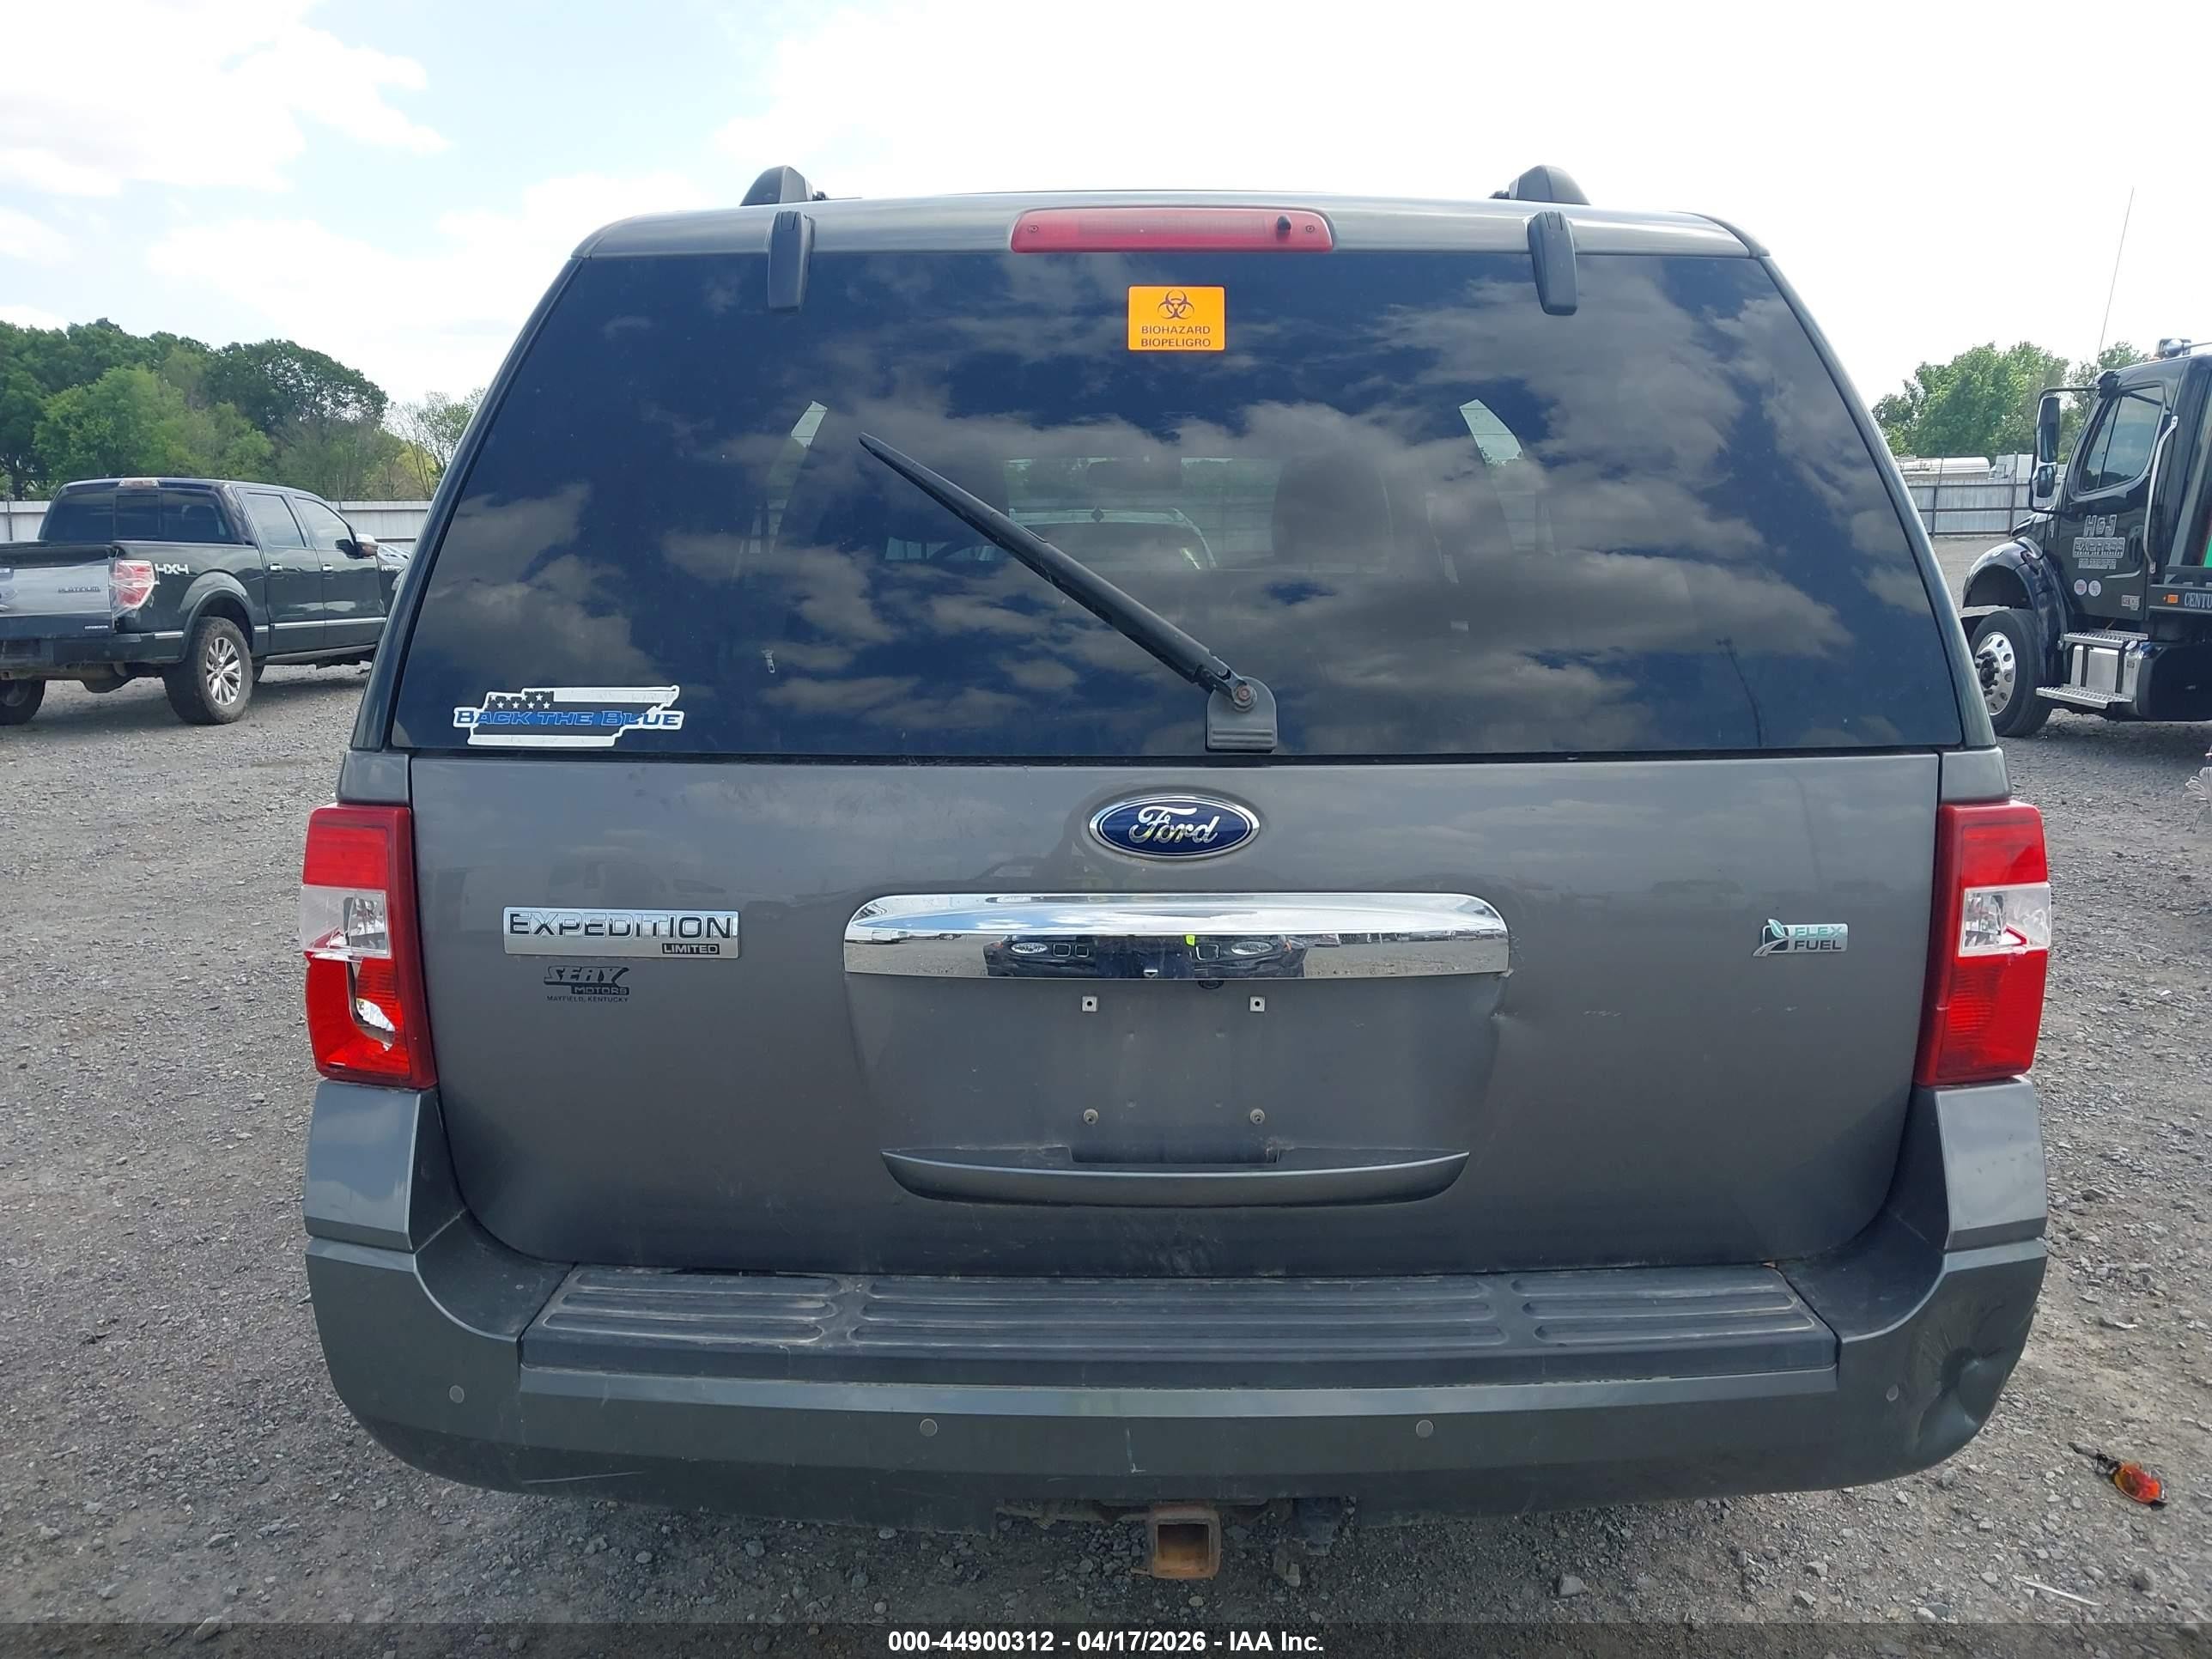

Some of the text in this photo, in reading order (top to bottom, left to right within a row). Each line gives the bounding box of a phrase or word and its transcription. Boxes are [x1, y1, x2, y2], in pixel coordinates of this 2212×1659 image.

[1141, 325, 1211, 334] BIOHAZARD
[1140, 337, 1211, 347] BIOPELIGRO
[155, 563, 189, 574] 4X4
[455, 710, 681, 726] BACK THE BLUE
[1128, 805, 1220, 844] Ford
[508, 912, 732, 939] EXPEDITION
[1794, 927, 1843, 938] FLEX
[663, 944, 720, 954] LIMITED
[1794, 940, 1842, 951] FUEL
[544, 966, 629, 986] SEAY
